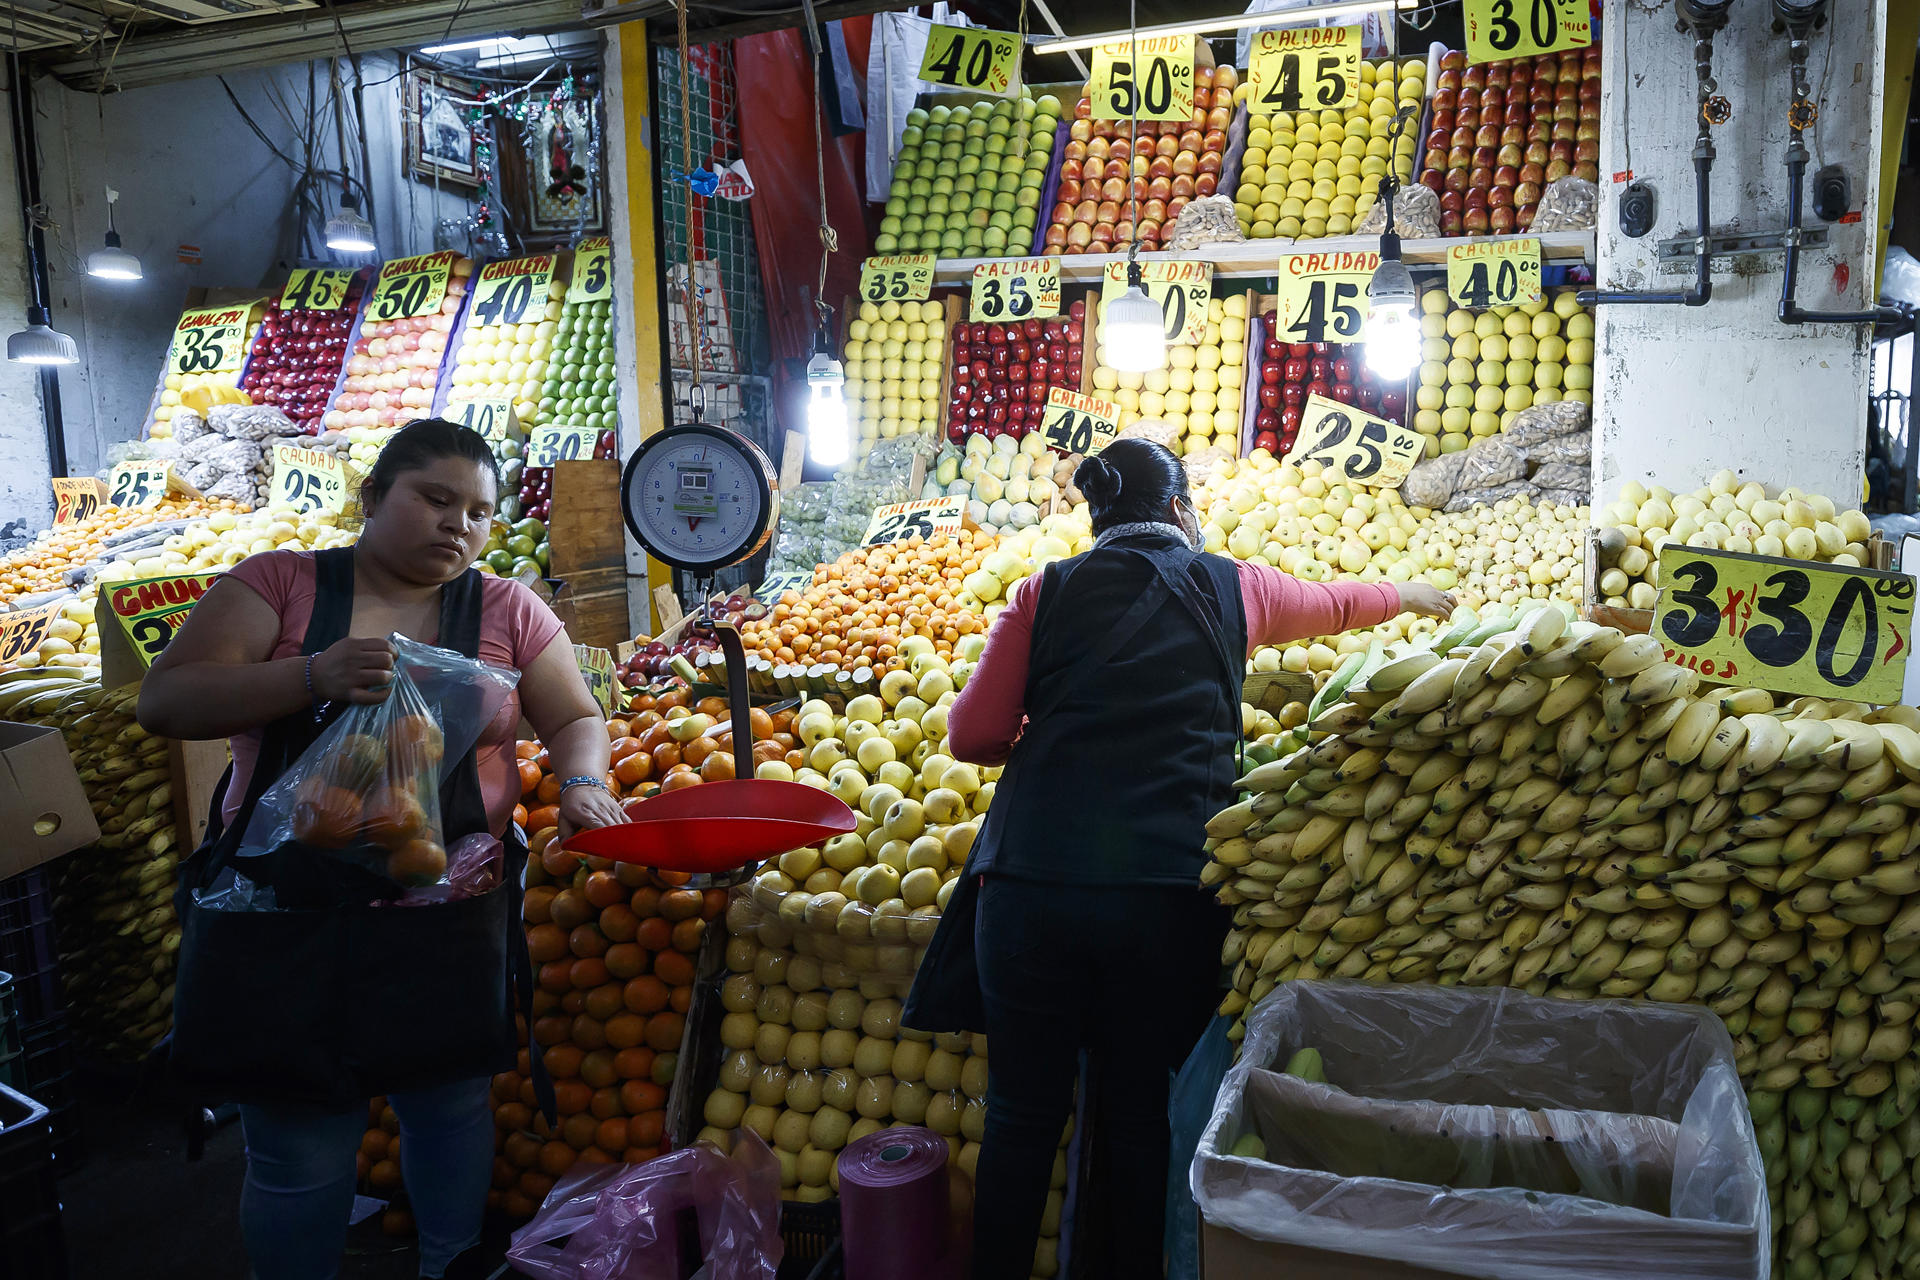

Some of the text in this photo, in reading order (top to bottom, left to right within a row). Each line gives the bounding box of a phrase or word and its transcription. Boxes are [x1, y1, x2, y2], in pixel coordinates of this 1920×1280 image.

[1262, 27, 1346, 49] CALIDAD
[1489, 0, 1558, 50] 30
[1564, 20, 1589, 32] KILO
[929, 34, 992, 86] 40
[1109, 57, 1172, 115] 50
[1261, 53, 1346, 111] 45
[869, 255, 929, 269] CALIDAD
[1289, 252, 1379, 275] CALIDAD
[1454, 239, 1530, 259] CALIDAD
[868, 271, 910, 299] 35
[974, 258, 1051, 278] CALIDAD
[1459, 260, 1518, 307] 40
[285, 269, 335, 309] 45
[378, 274, 431, 318] 50
[476, 274, 532, 326] 40
[982, 276, 1033, 317] 35
[1287, 281, 1361, 342] 45
[179, 328, 226, 372] 35
[1046, 409, 1093, 454] 40
[1292, 411, 1388, 479] 25
[280, 447, 335, 470] CALIDAD
[538, 432, 581, 467] 30
[111, 472, 149, 507] 25
[734, 481, 740, 489] 2
[656, 508, 661, 516] 7
[736, 507, 741, 516] 3
[879, 496, 952, 518] CALIDAD
[671, 527, 677, 535] 6
[697, 534, 703, 542] 5
[721, 527, 726, 535] 4
[869, 510, 934, 545] 25
[1661, 560, 1721, 647] 3
[1744, 569, 1879, 687] 30
